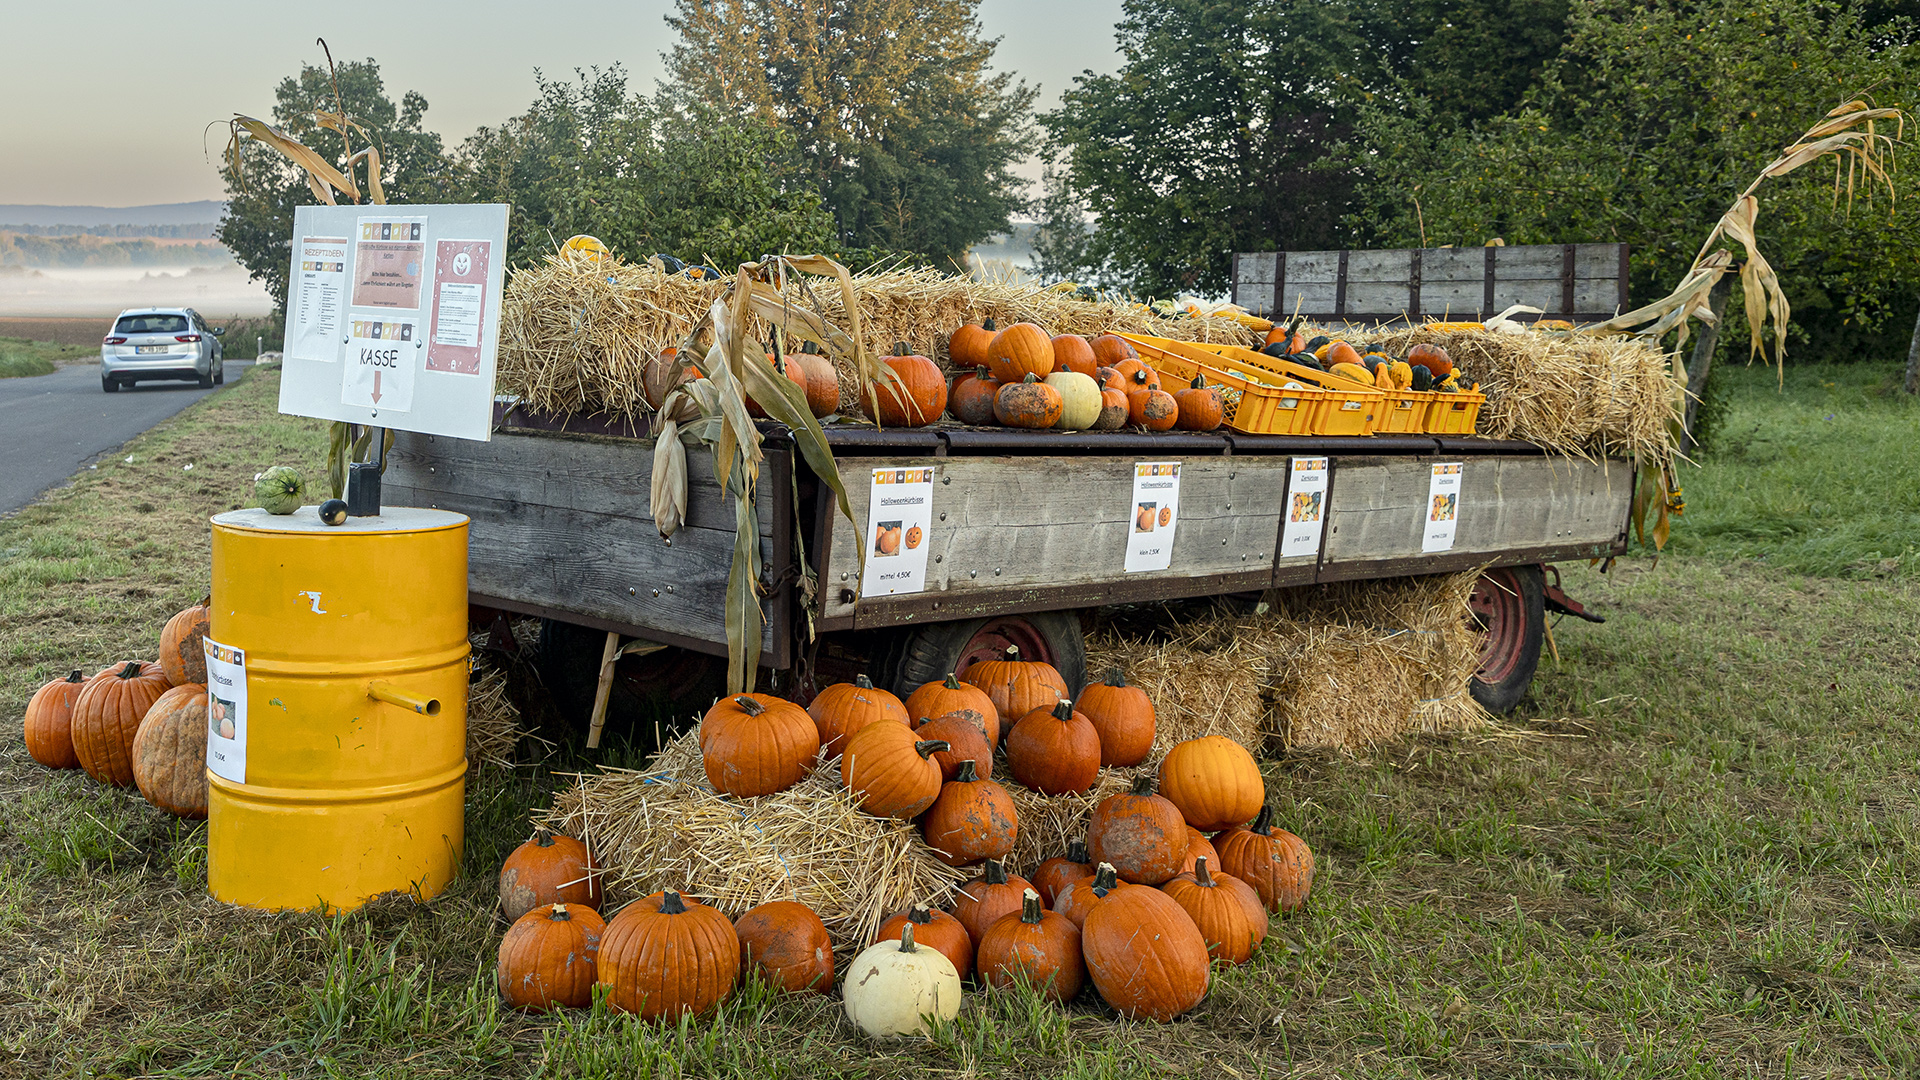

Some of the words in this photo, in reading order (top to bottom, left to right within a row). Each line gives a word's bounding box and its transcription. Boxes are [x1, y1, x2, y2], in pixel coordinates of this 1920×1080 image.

[304, 248, 344, 257] REZEPTIDEEN
[360, 347, 398, 368] KASSE
[881, 497, 924, 505] Halloweenkürbisse
[880, 572, 895, 580] mittel
[896, 570, 912, 580] 4,50€
